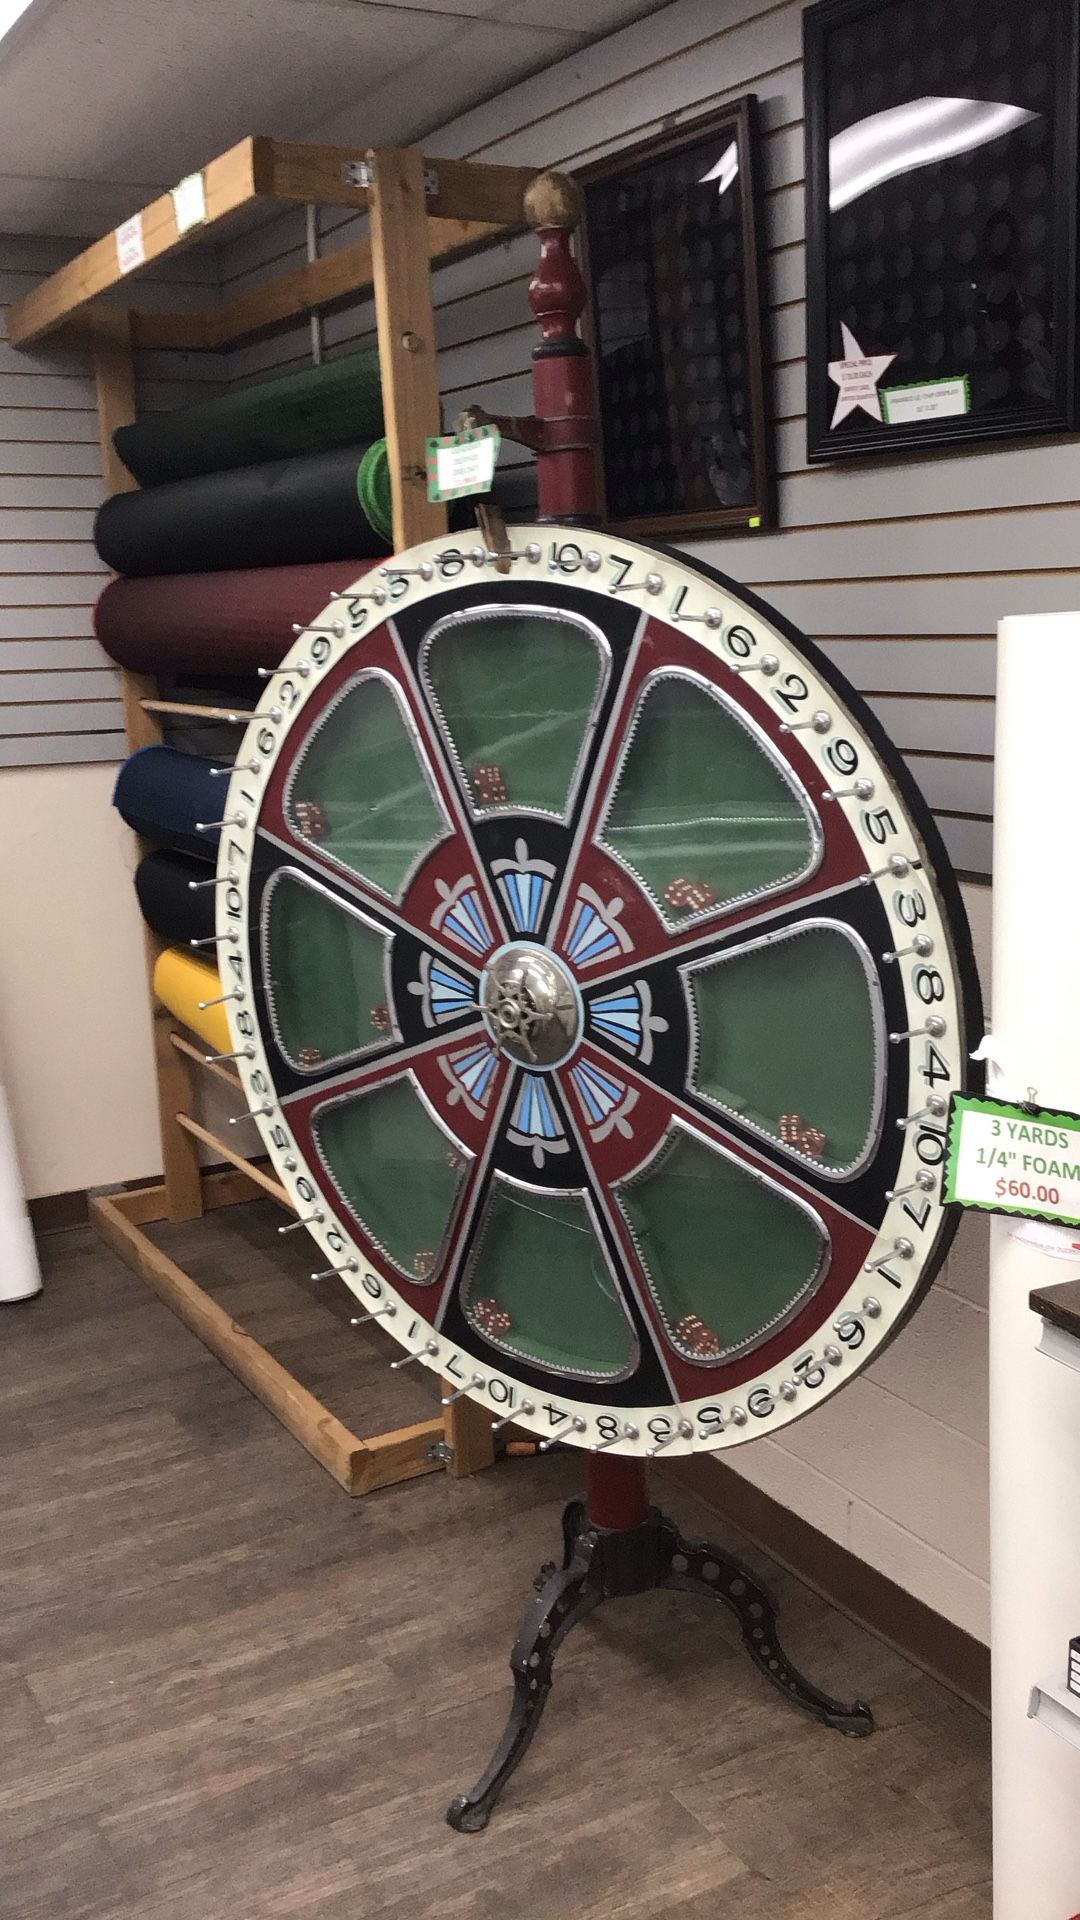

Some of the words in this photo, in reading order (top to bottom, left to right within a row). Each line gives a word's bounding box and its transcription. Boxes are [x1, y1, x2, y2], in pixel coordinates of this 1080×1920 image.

[440, 548, 464, 580] 8
[548, 542, 583, 575] 10
[608, 554, 634, 587] 7
[347, 596, 367, 629] 5
[669, 585, 689, 615] 1
[722, 623, 757, 660] 6
[280, 680, 301, 712] 2
[771, 673, 809, 714] 2
[823, 736, 859, 777] 9
[240, 789, 256, 807] 1
[860, 807, 898, 845] 5
[228, 839, 247, 864] 7
[225, 887, 243, 920] 10
[892, 889, 927, 928] 3
[228, 950, 244, 983] 4
[912, 962, 945, 1005] 8
[918, 1040, 951, 1089] 4
[913, 1121, 946, 1166] 10
[991, 1119, 1002, 1137] 3
[1006, 1121, 1069, 1149] YARDS
[976, 1147, 1017, 1169] 1/4"
[1022, 1154, 1080, 1182] FOAM
[994, 1176, 1060, 1205] $60.00
[901, 1198, 931, 1232] 7
[326, 1222, 348, 1253] 2
[877, 1264, 904, 1290] 1
[408, 1320, 420, 1339] 1
[445, 1354, 465, 1380] 7
[487, 1377, 517, 1409] 10
[542, 1402, 572, 1428] 4
[596, 1413, 622, 1440] 8
